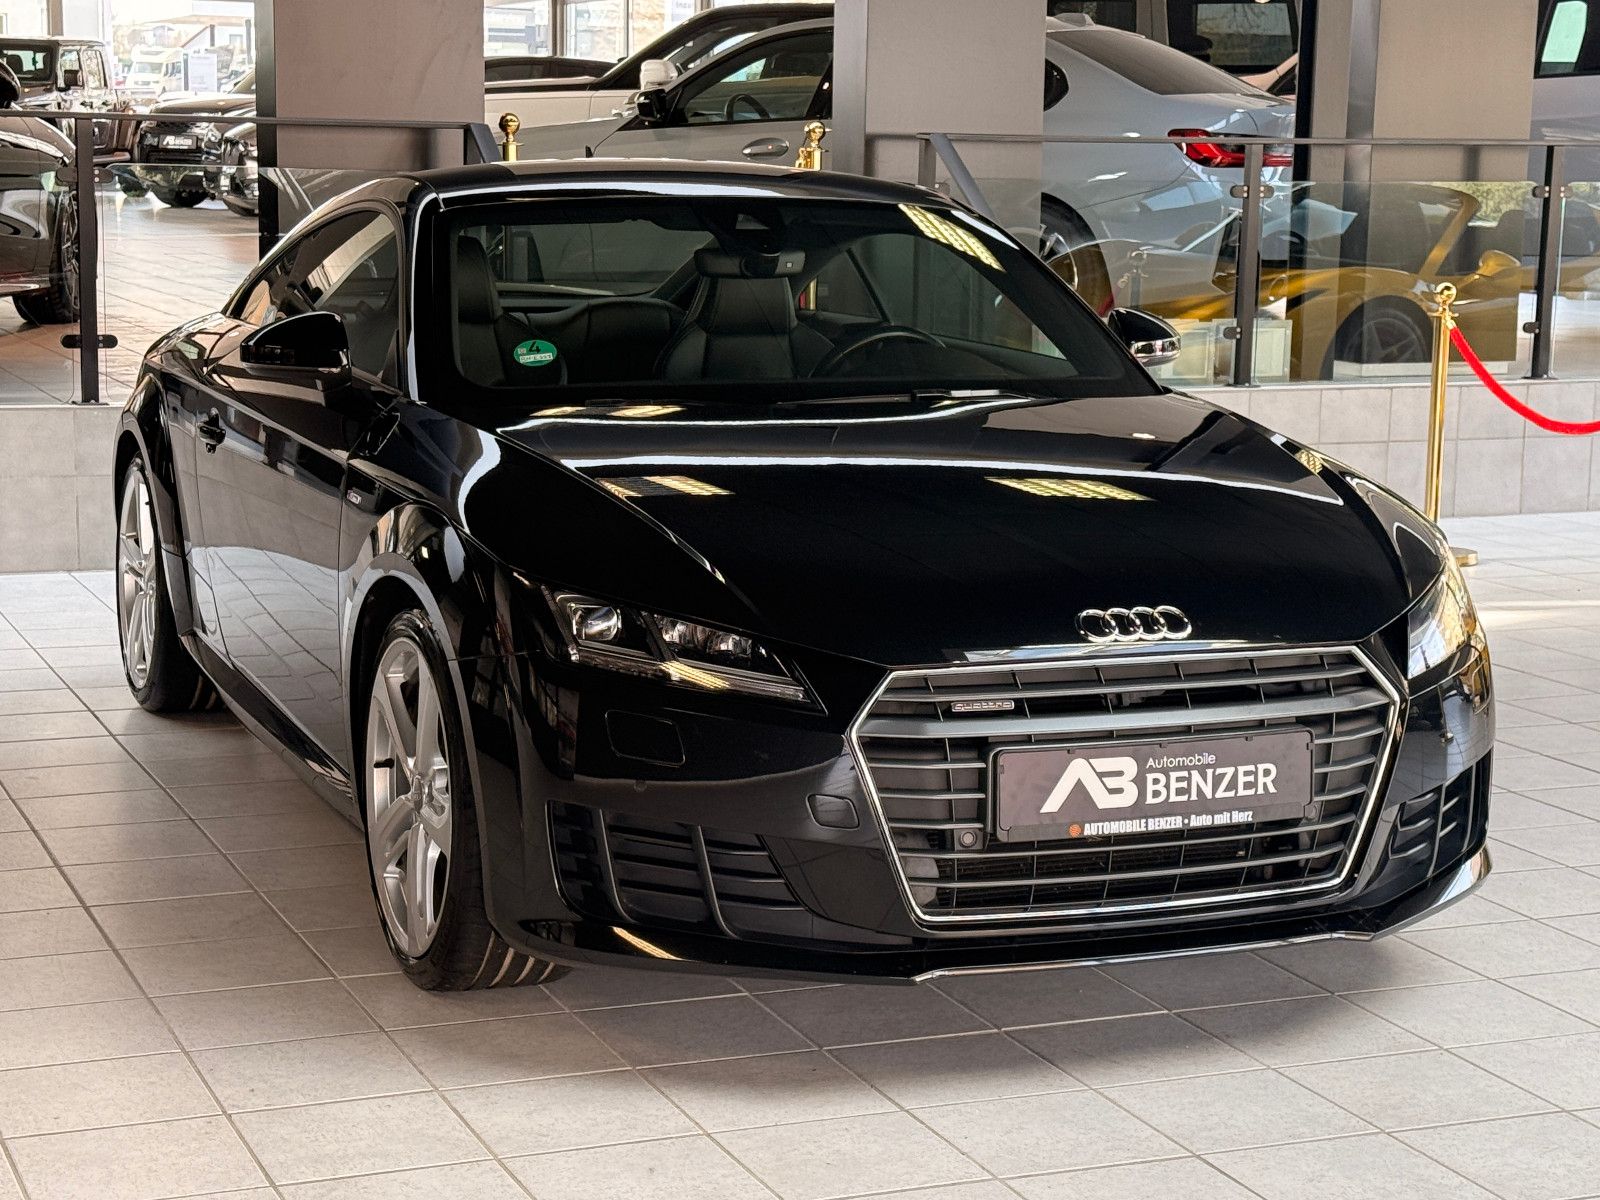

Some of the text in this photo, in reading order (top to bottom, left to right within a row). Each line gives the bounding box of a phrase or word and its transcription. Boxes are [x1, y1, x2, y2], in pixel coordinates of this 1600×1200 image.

[529, 340, 541, 354] 4
[954, 702, 1012, 711] quattro
[1146, 753, 1216, 769] Automobile
[1145, 763, 1277, 804] BENZER
[1083, 810, 1253, 836] AUTOMOBILE BENZER Auto mit Herz
